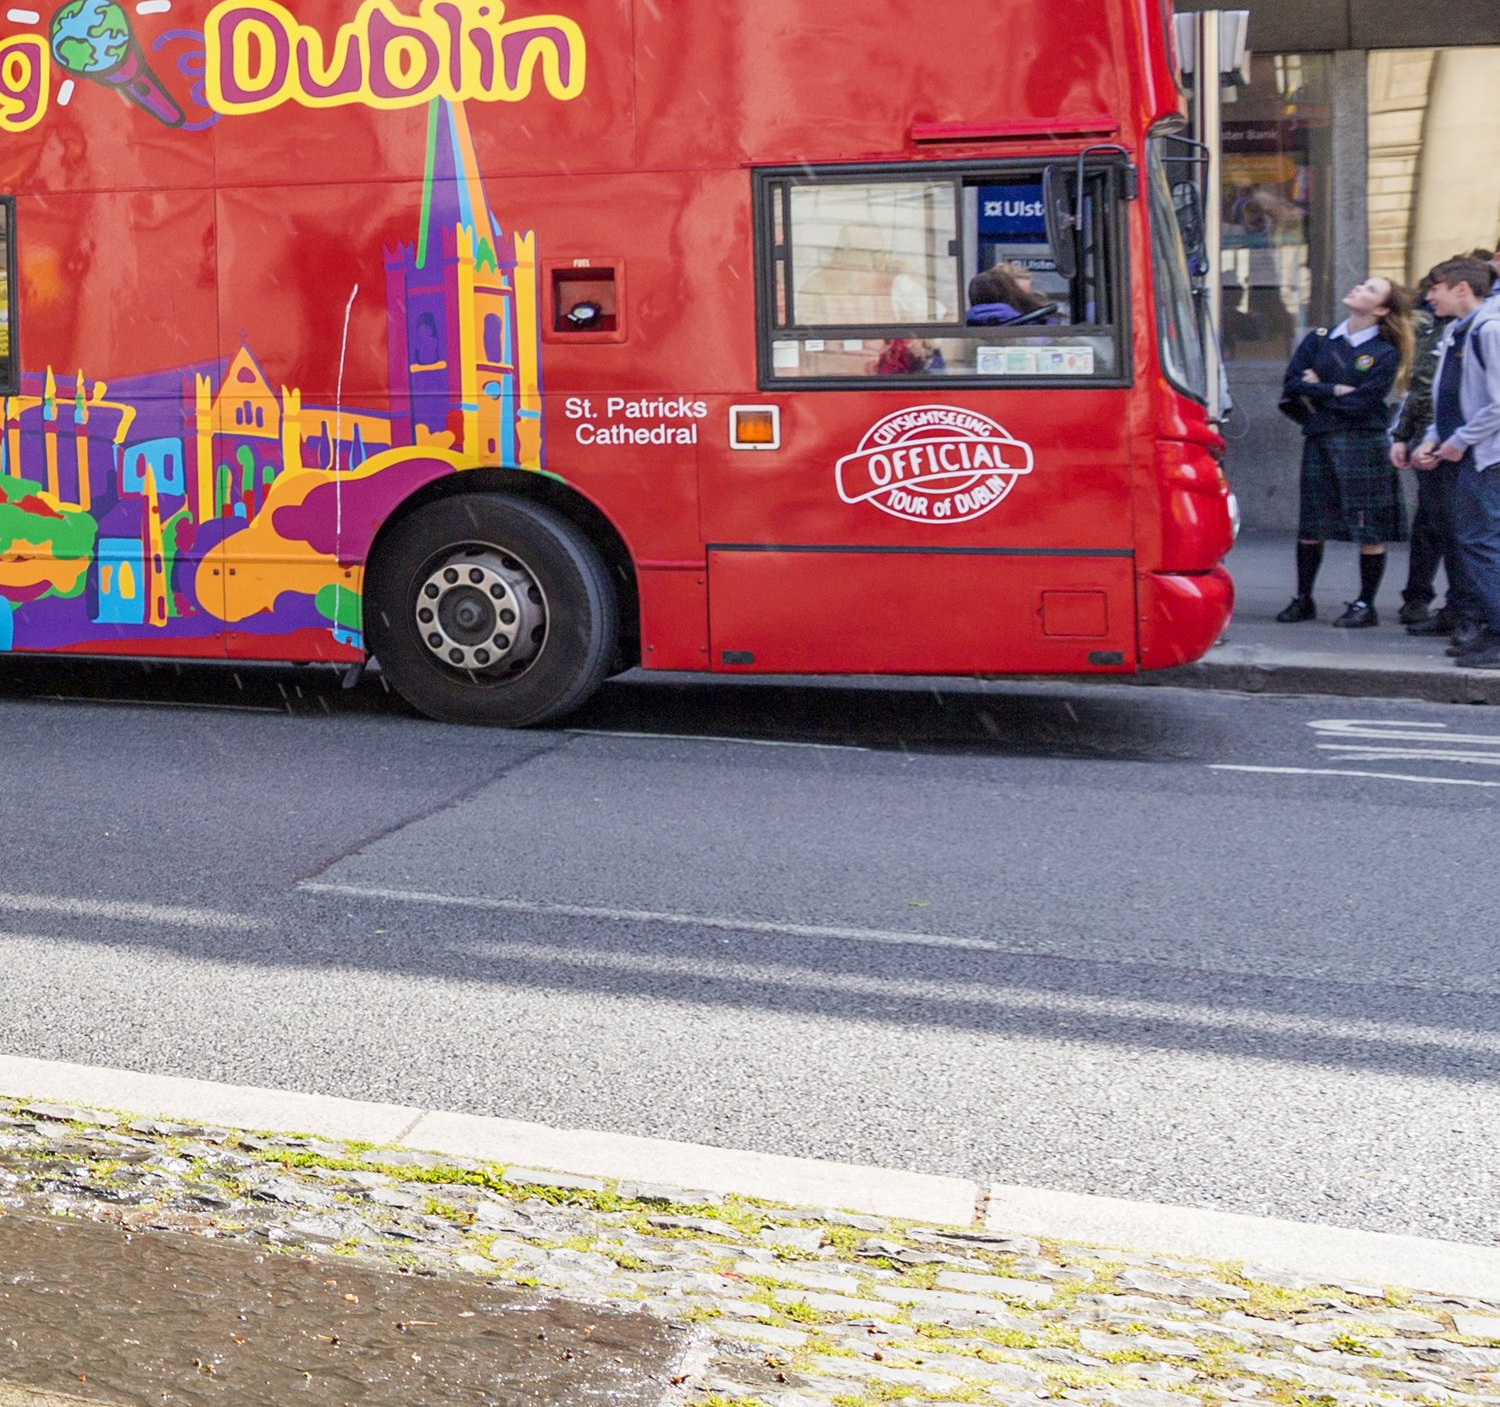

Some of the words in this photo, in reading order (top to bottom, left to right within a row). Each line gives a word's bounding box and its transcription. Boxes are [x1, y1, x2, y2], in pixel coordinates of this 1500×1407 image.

[1004, 200, 1045, 216] Ulst
[573, 259, 591, 267] FUEL
[1025, 259, 1056, 270] Ulste
[565, 397, 598, 419] St.
[607, 396, 708, 419] Patricks
[575, 423, 698, 445] Cathedral
[873, 411, 993, 445] CITYSIGHTSEEING
[868, 443, 1010, 486] OFFICIAL
[886, 489, 928, 516] TOUR
[954, 475, 1007, 514] DUBLIN
